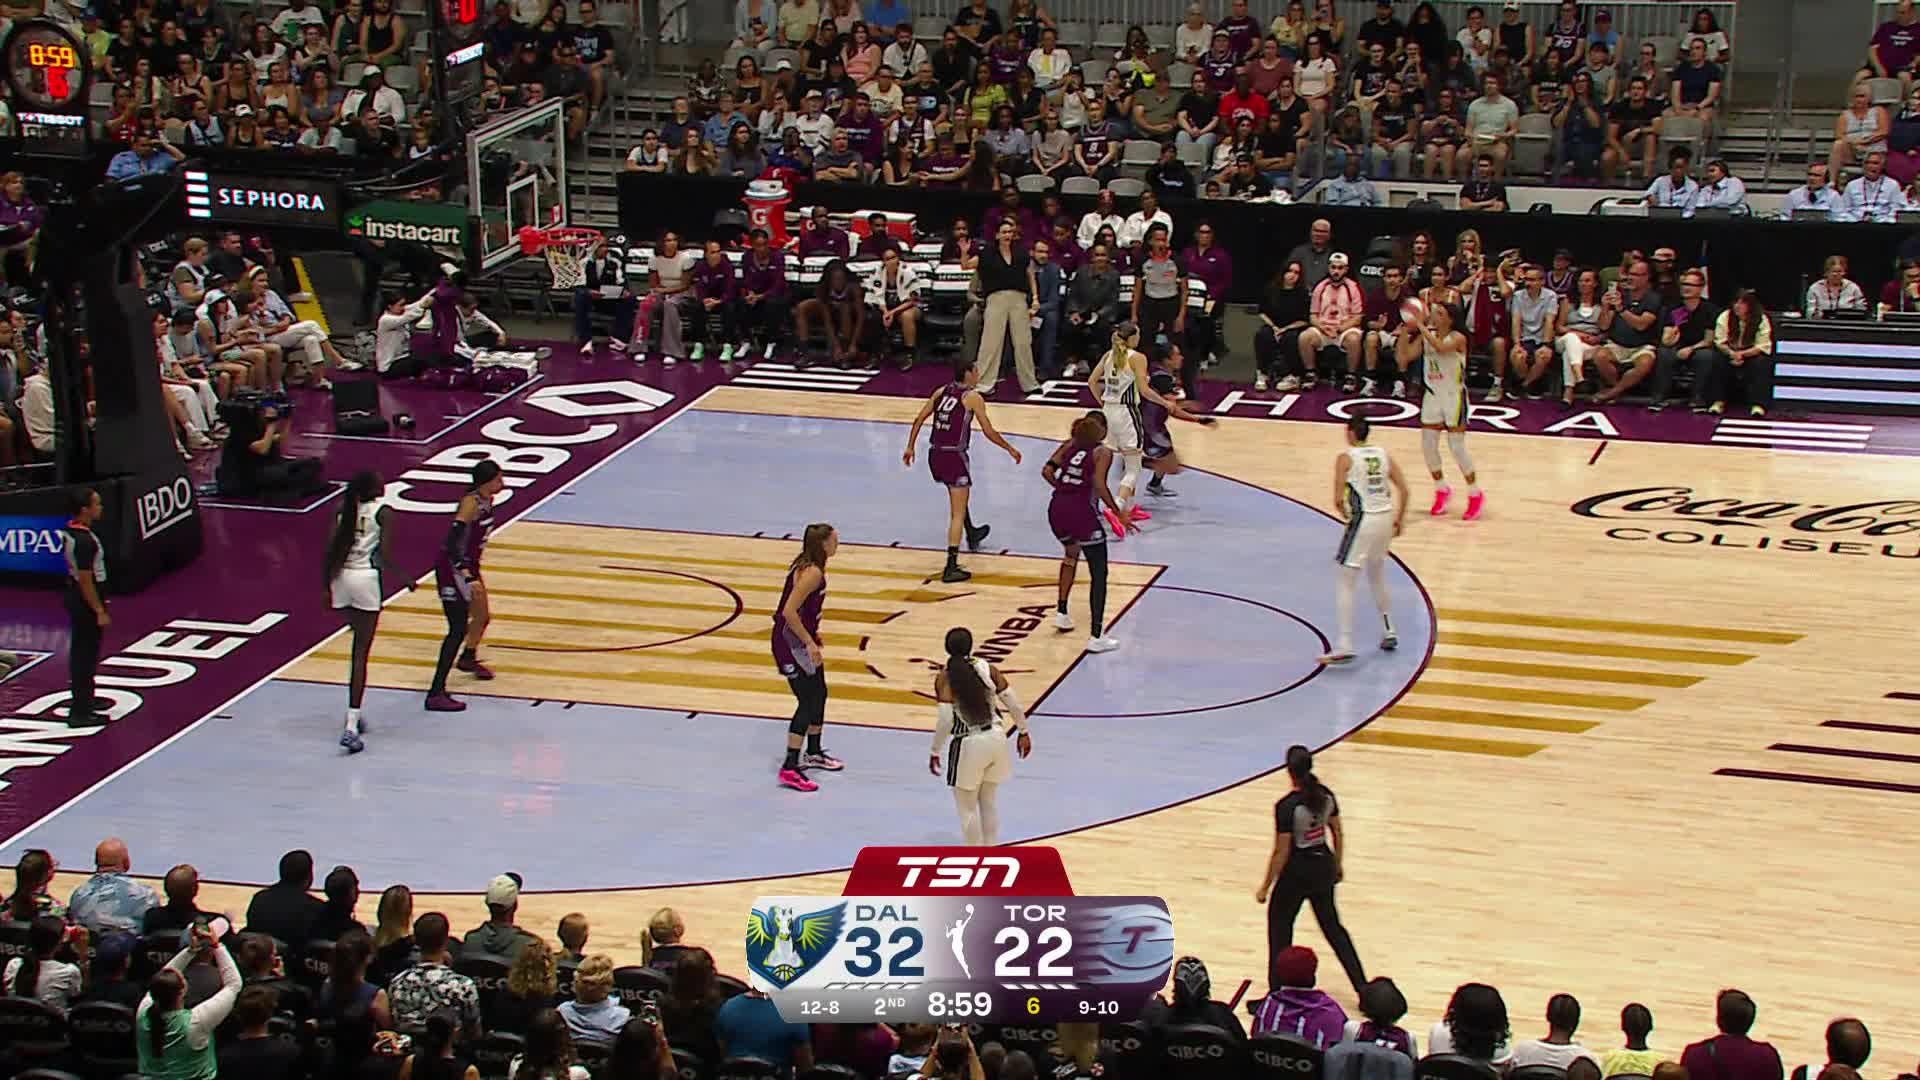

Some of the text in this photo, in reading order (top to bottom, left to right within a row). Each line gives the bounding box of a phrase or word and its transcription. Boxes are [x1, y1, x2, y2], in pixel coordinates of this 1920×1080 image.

[30, 44, 73, 68] 8:59
[217, 187, 326, 212] SEPHORA
[752, 209, 767, 226] G
[365, 216, 461, 245] instacart
[937, 396, 958, 411] 10
[1070, 450, 1087, 465] 8
[143, 476, 192, 528] BDO
